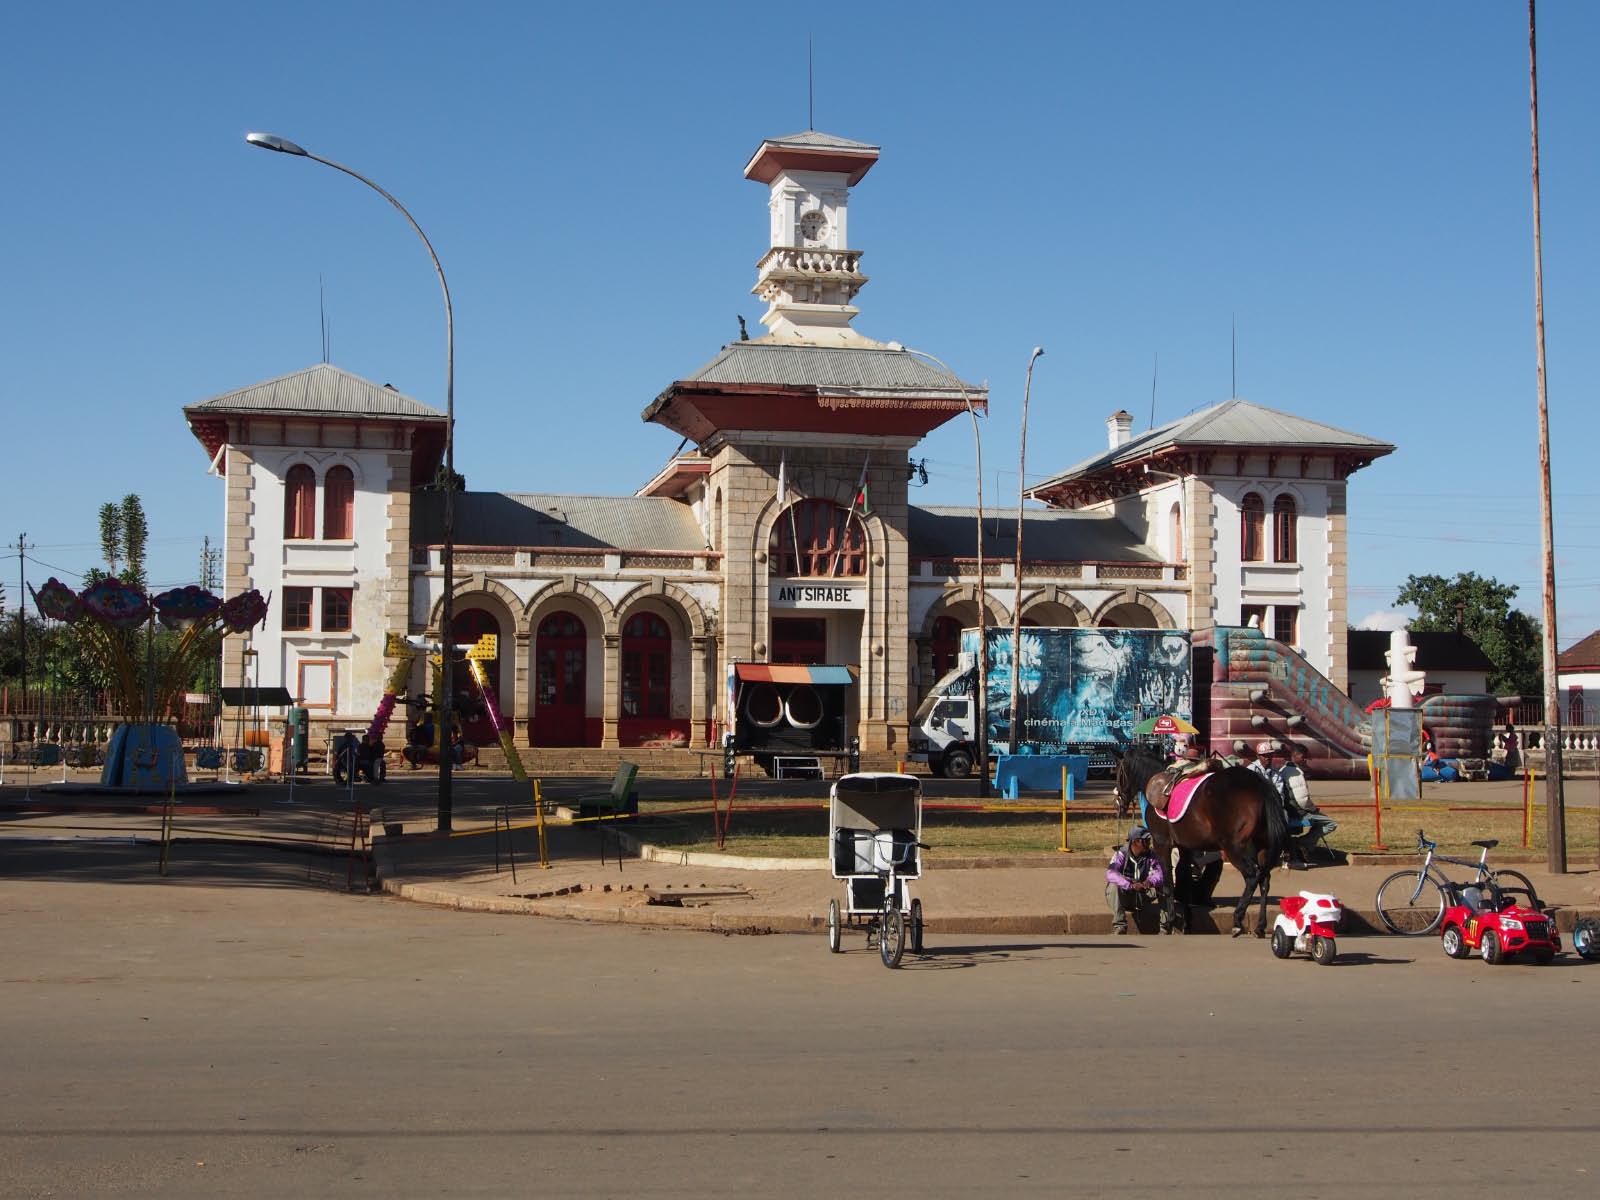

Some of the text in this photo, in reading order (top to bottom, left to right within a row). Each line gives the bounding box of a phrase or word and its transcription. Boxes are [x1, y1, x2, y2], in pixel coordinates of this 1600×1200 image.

[779, 587, 852, 602] ANTSIRABE
[1024, 717, 1067, 727] cinéma
[1081, 718, 1134, 729] Madagas
